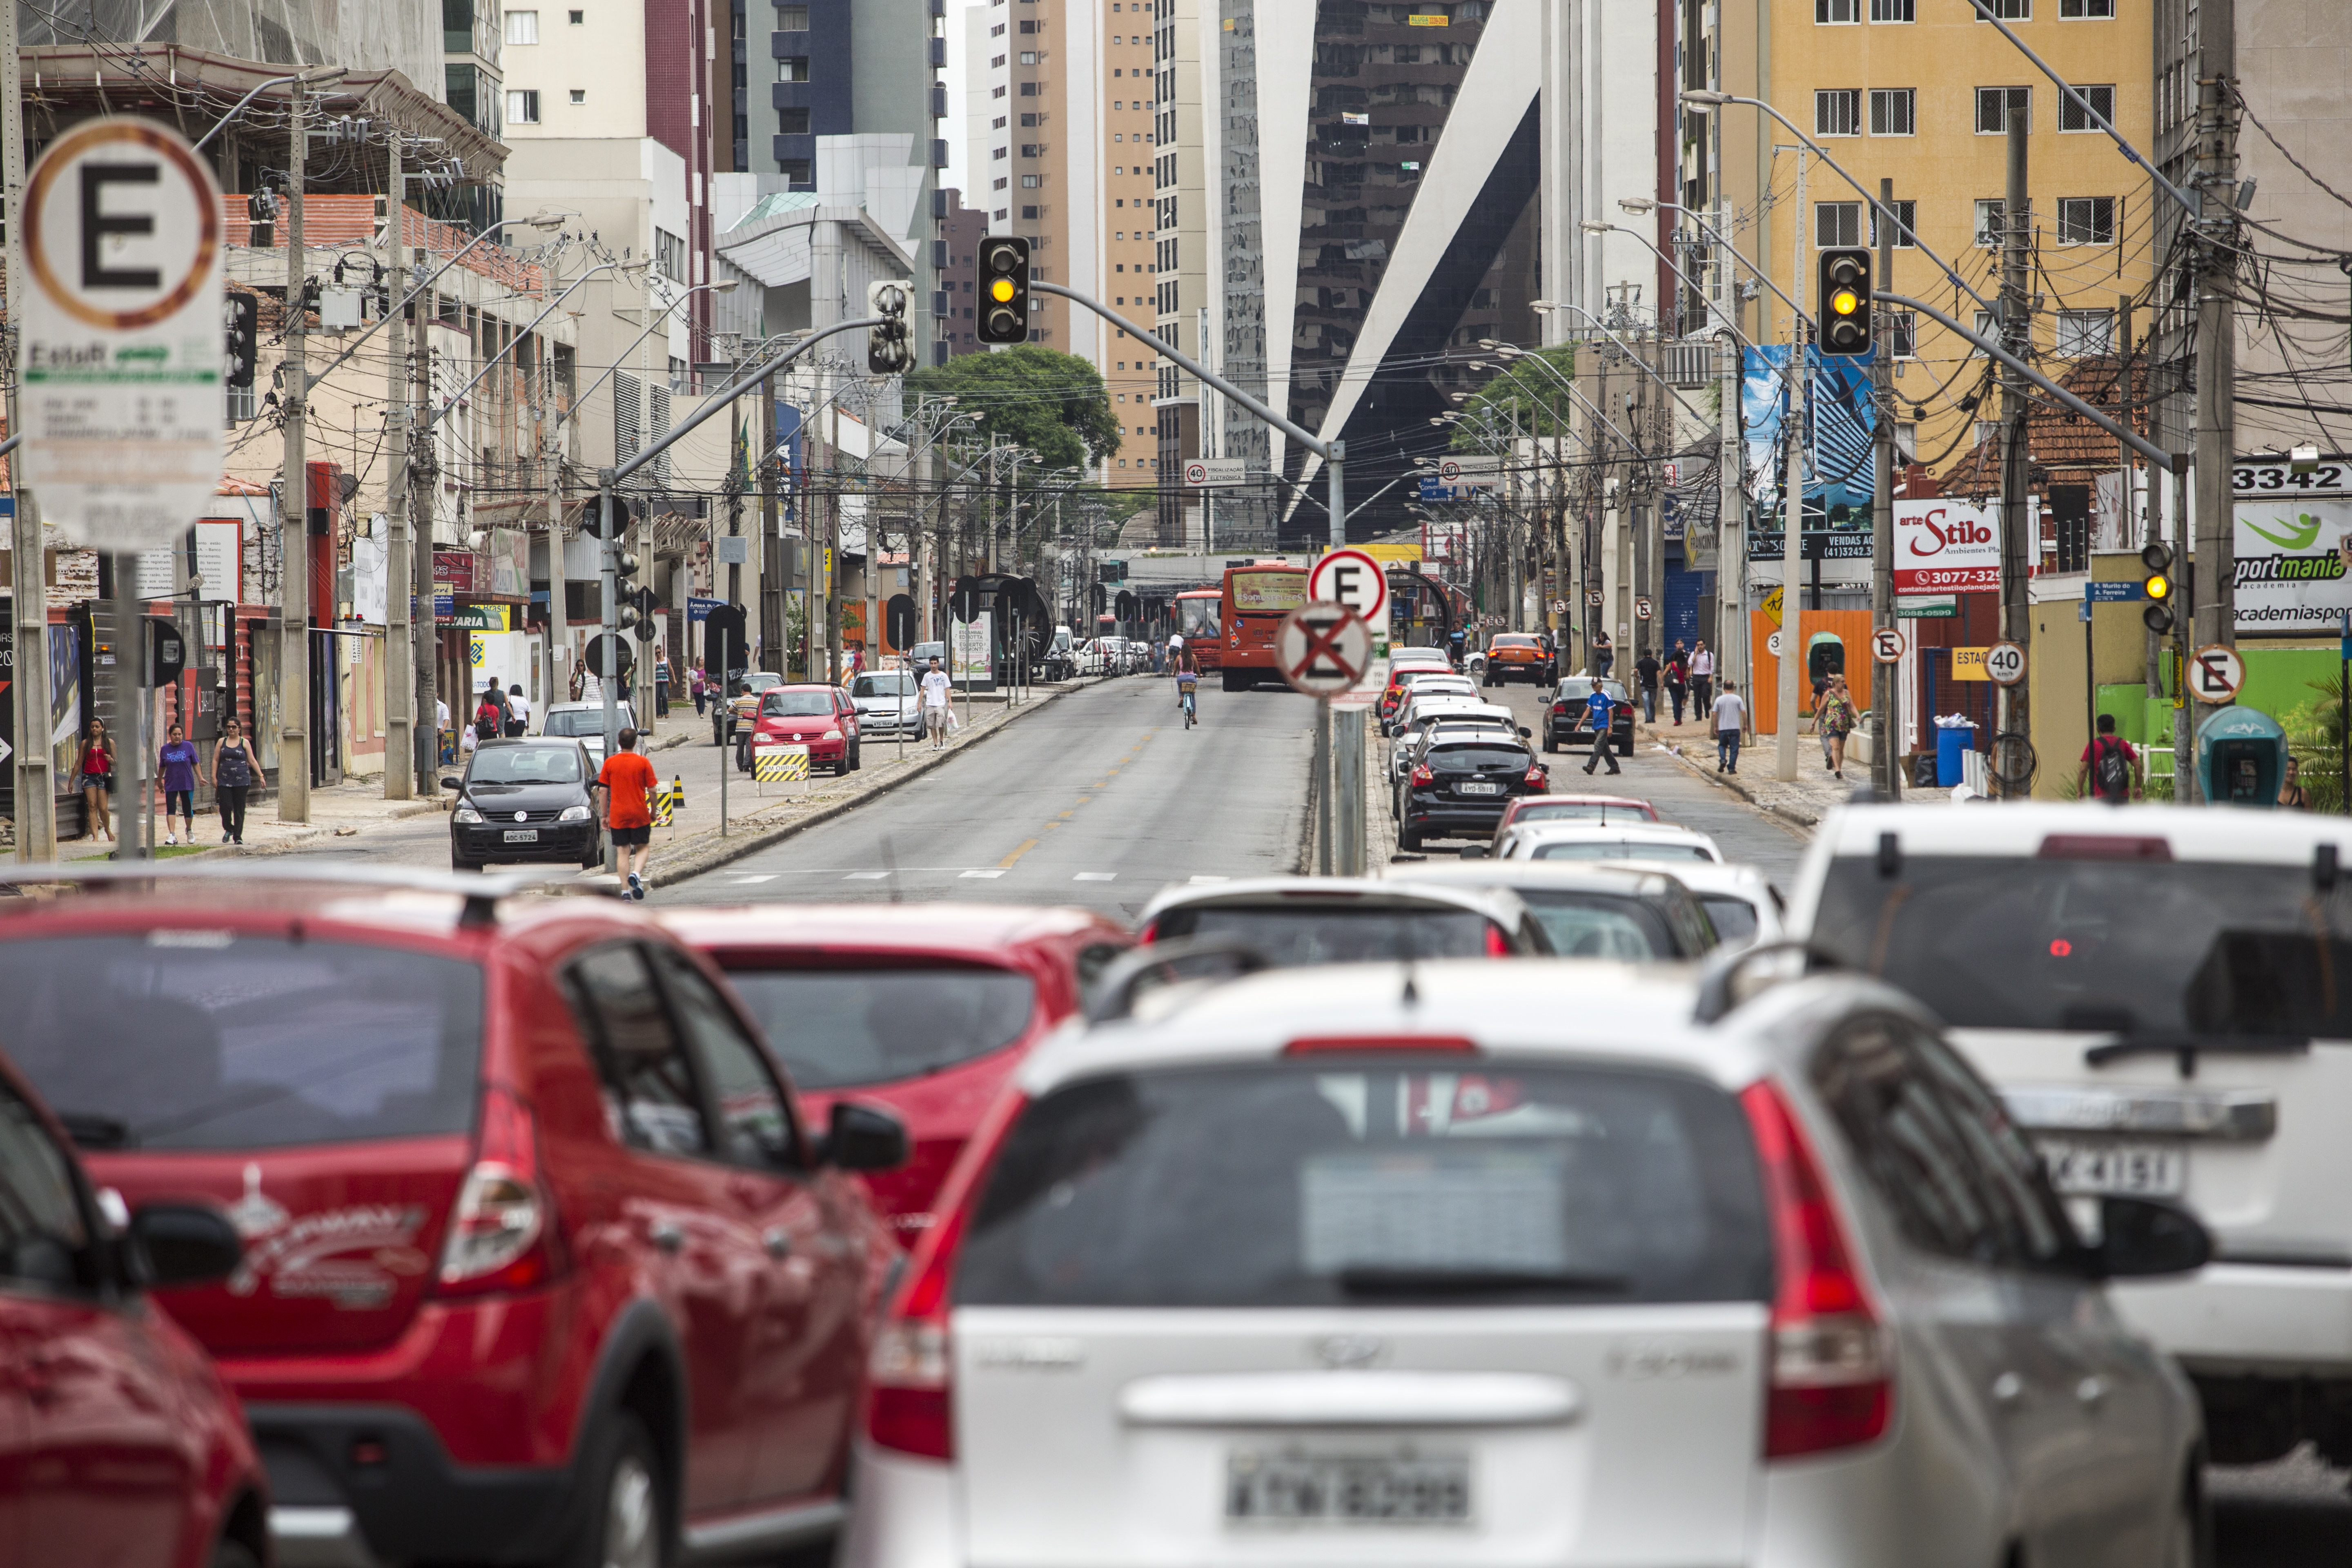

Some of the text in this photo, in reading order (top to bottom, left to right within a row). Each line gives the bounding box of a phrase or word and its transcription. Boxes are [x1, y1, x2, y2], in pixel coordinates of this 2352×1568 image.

[80, 164, 161, 287] E
[1191, 469, 1203, 477] 40
[2233, 467, 2342, 490] 3342
[1829, 536, 1861, 546] VENDAS
[1900, 509, 1991, 557] arte Stilo
[2234, 552, 2344, 586] portmania
[1335, 567, 1361, 610] E
[1592, 592, 1599, 604] E
[1557, 602, 1563, 612] E
[1640, 602, 1648, 616] E
[1771, 636, 1782, 648] 3
[1880, 635, 1895, 656] E
[1992, 651, 2019, 670] 40
[2203, 655, 2228, 692] E
